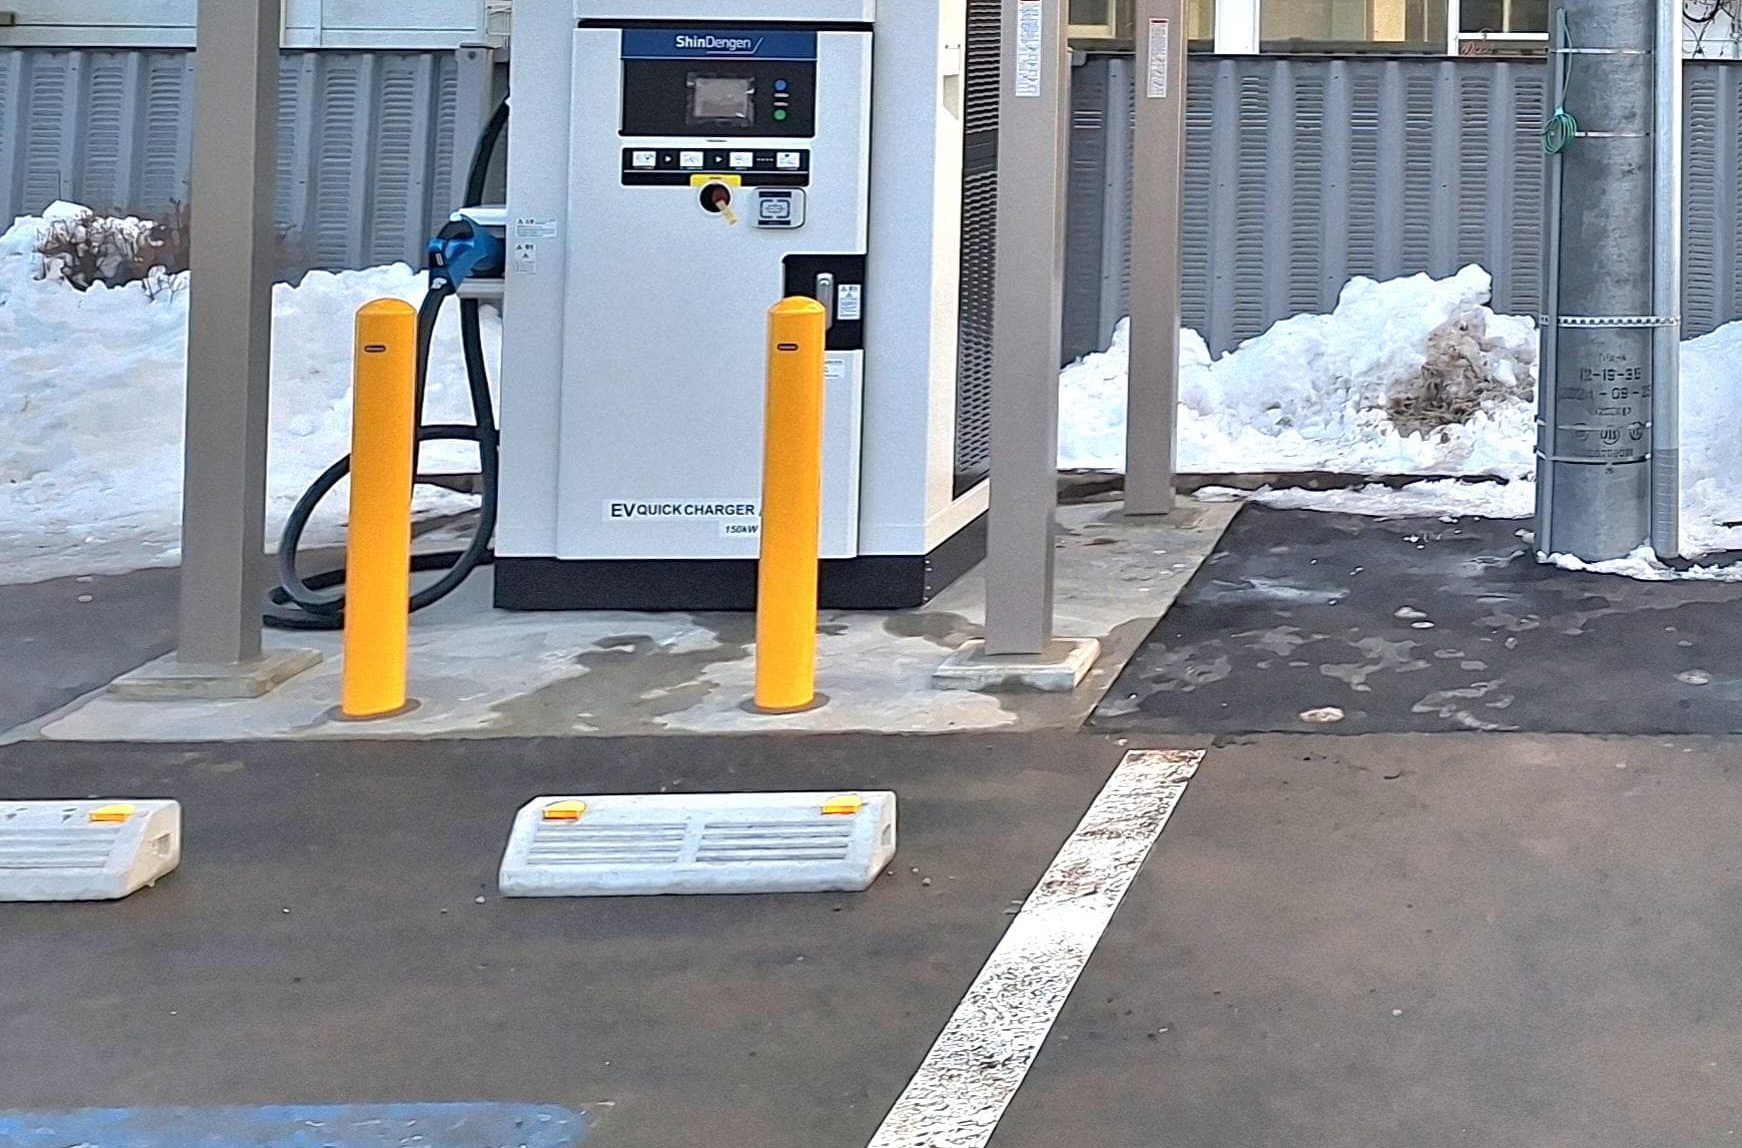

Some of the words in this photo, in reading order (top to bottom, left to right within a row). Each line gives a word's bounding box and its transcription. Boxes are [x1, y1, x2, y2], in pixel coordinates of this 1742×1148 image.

[676, 35, 752, 51] ShinDengen
[611, 503, 636, 518] EV
[636, 504, 682, 516] QUICK
[684, 504, 756, 516] CHARGER
